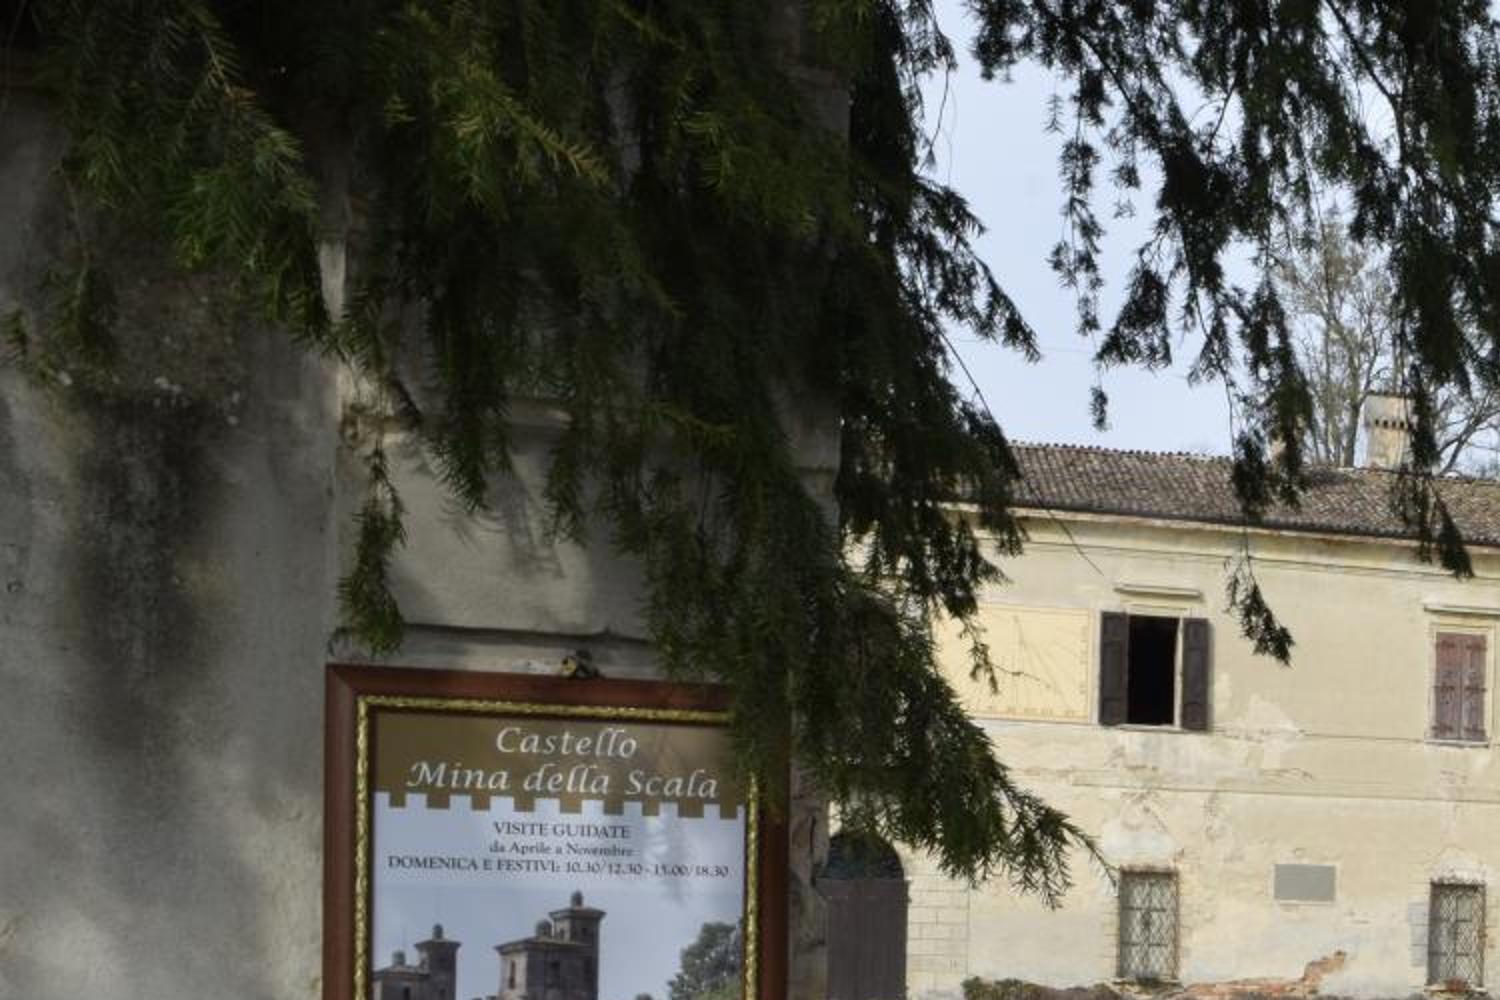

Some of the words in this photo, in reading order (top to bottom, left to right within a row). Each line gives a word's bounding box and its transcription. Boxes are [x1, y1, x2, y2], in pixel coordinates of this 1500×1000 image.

[496, 726, 638, 758] Castello
[405, 761, 510, 790] Mina
[522, 763, 611, 795] della
[625, 769, 720, 798] Scala
[493, 821, 548, 837] VISITE
[553, 823, 631, 839] GUIDATE
[489, 839, 505, 853] da
[510, 841, 552, 856] Aprile
[555, 847, 563, 855] a
[566, 842, 634, 857] Novembre
[387, 855, 478, 870] DOMENICA
[483, 858, 493, 871] E
[497, 858, 560, 873] FESTIVI:
